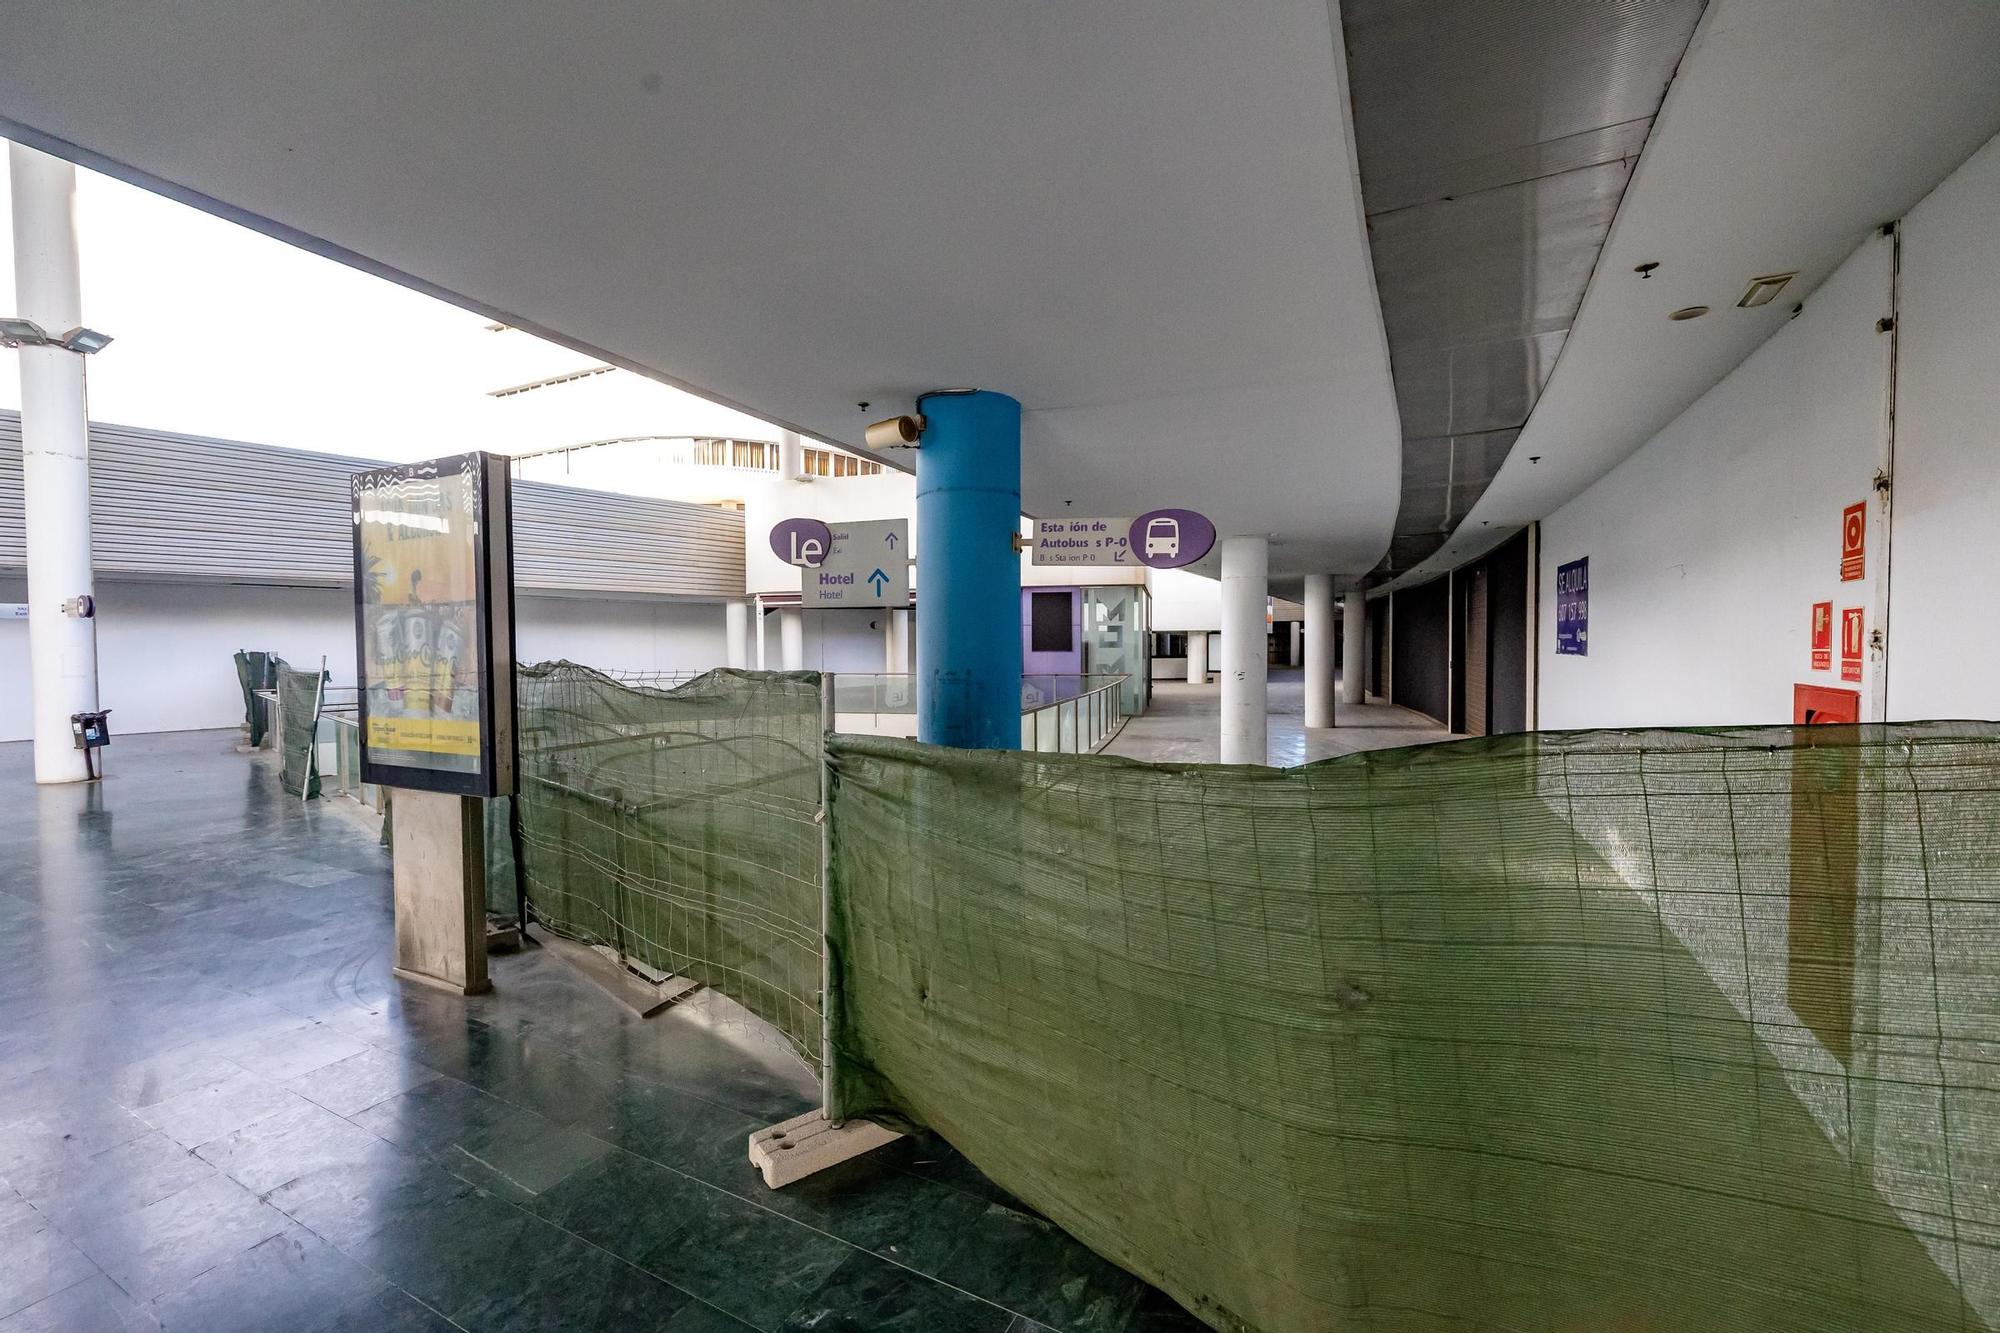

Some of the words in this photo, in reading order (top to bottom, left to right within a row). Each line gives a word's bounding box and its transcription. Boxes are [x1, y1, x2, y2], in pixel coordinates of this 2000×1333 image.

[1041, 521, 1088, 533] Estaión
[1091, 521, 1107, 532] de
[1040, 537, 1102, 548] Autobuss
[1105, 537, 1128, 548] P-0
[790, 531, 823, 569] Le
[1055, 553, 1080, 562] Staion
[819, 572, 855, 585] Hotel
[1558, 572, 1565, 594] SE
[1565, 565, 1588, 594] ALQUILA
[819, 589, 844, 600] Hotel
